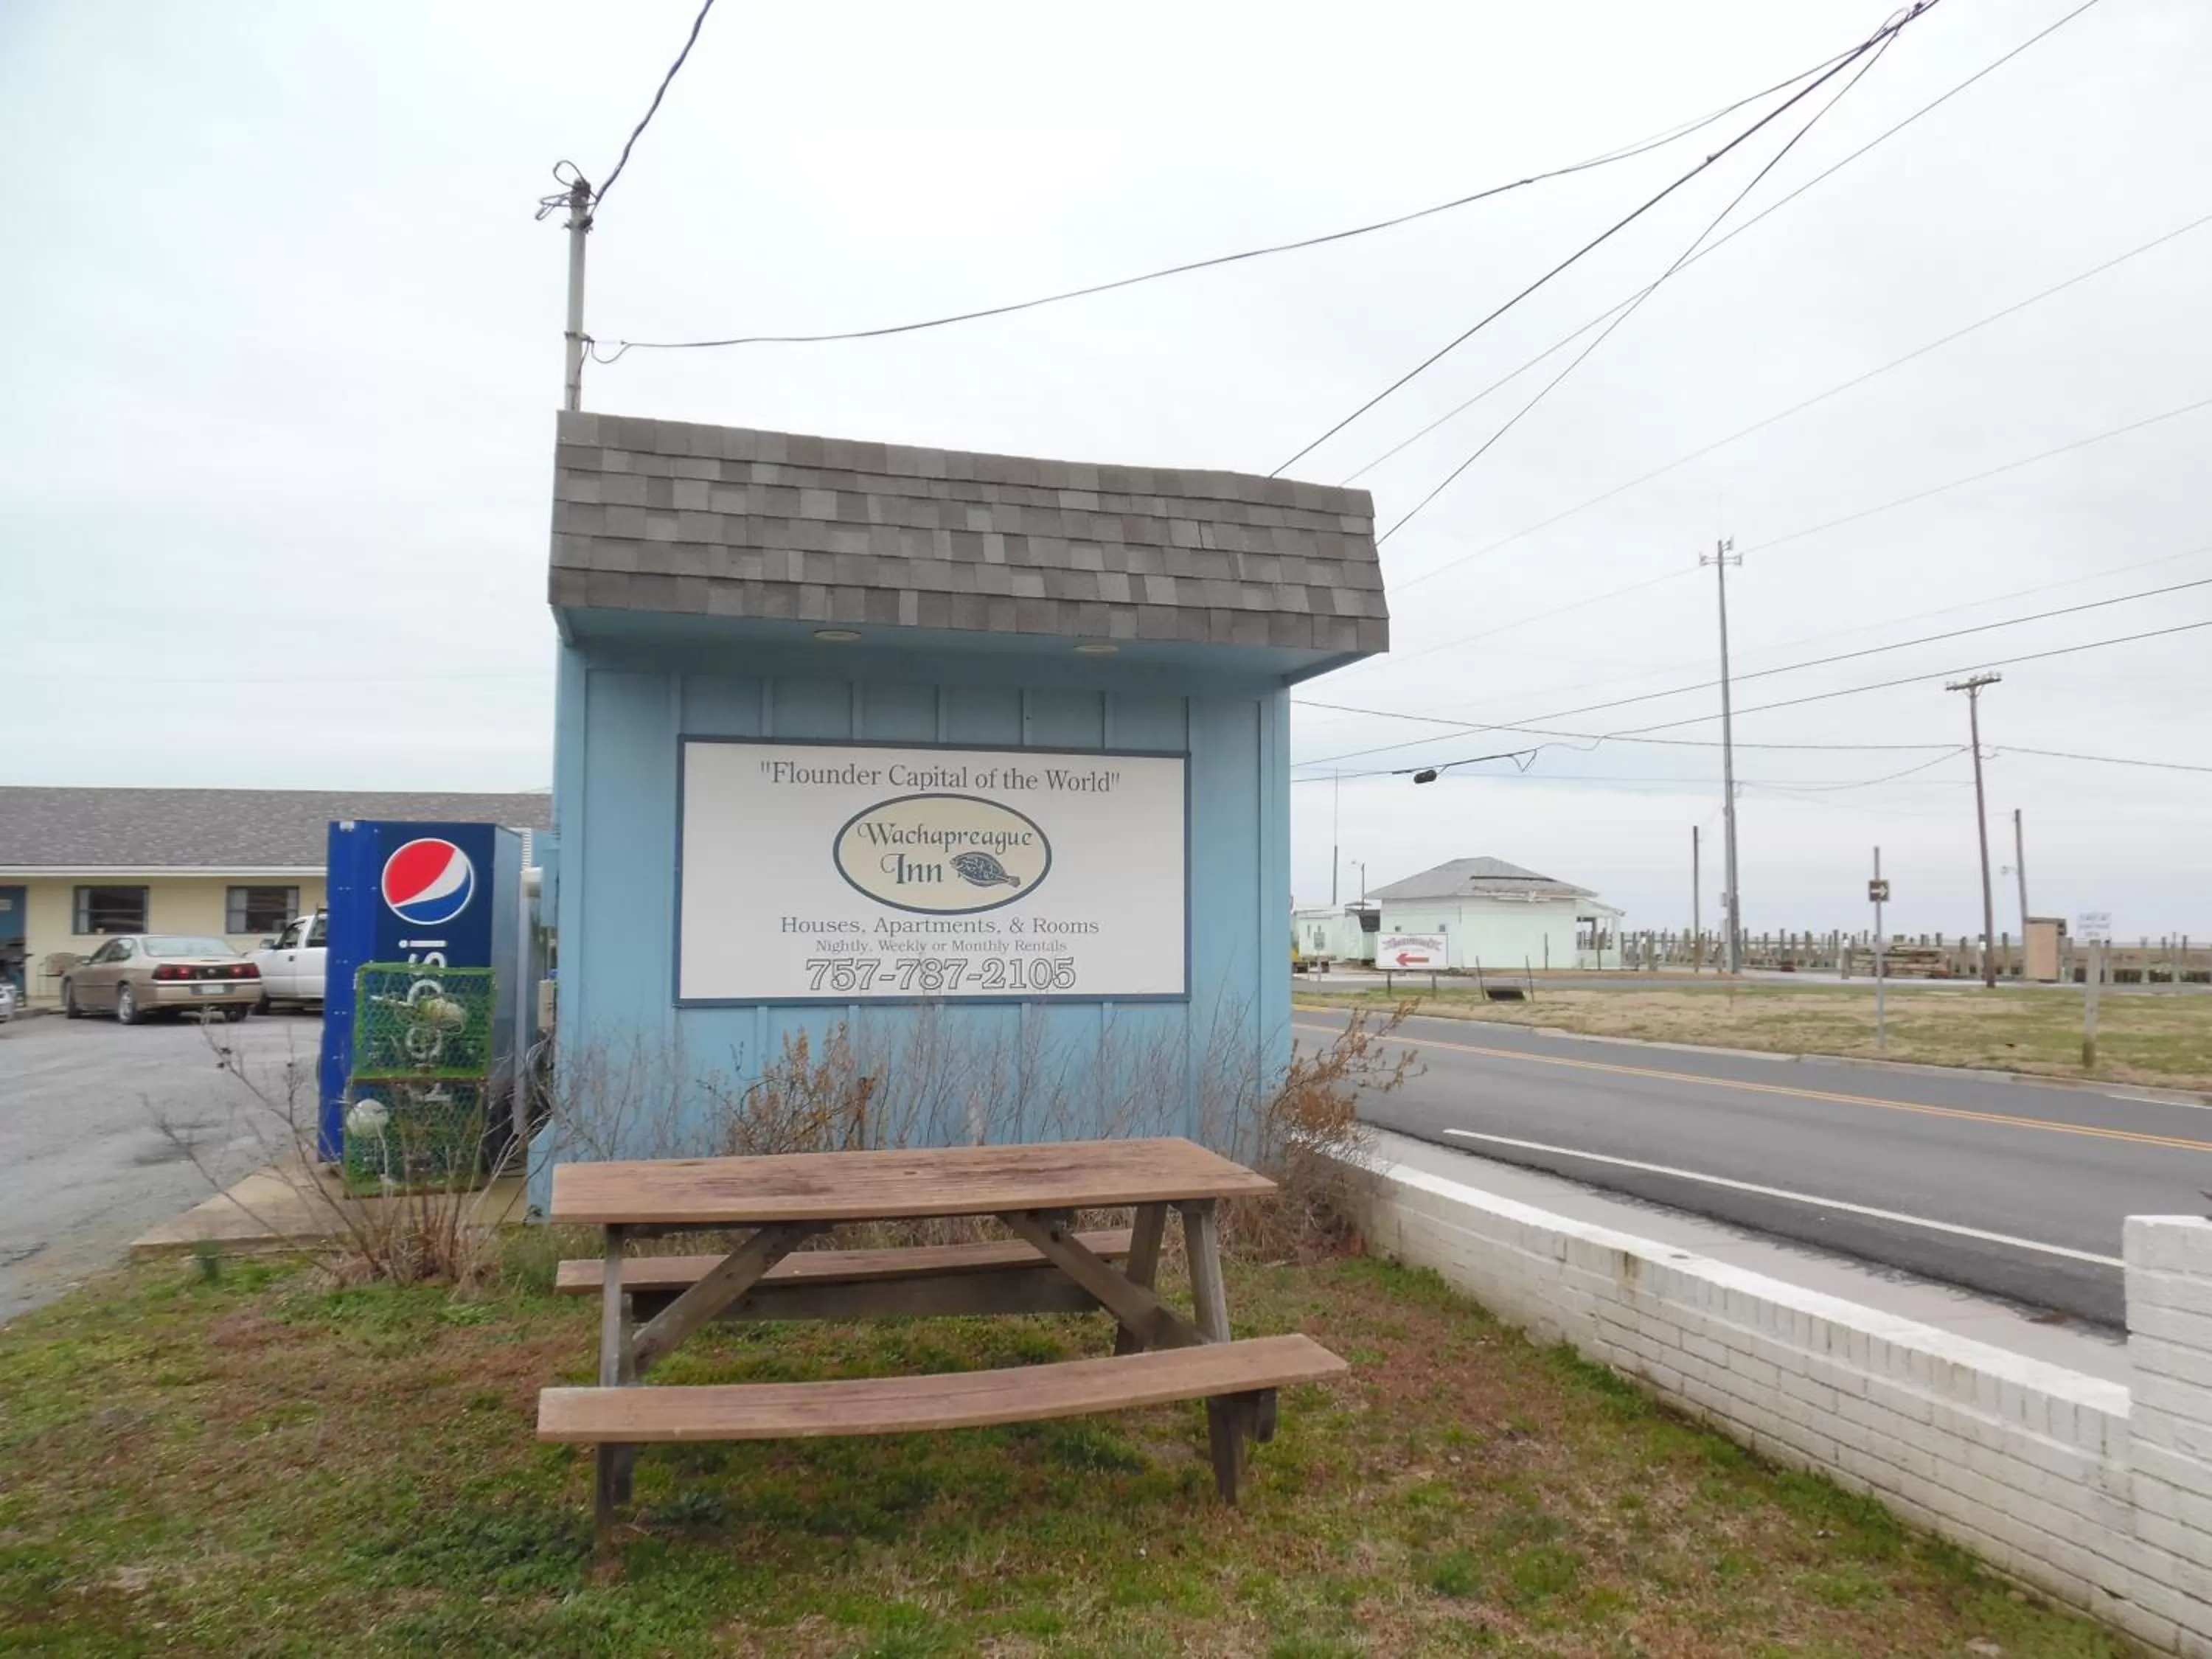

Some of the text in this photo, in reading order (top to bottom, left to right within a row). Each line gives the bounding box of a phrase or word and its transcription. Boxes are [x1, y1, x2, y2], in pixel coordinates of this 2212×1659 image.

[760, 760, 1121, 793] "Flounder Capital of the World"
[857, 822, 1033, 856] Wachapreague
[880, 852, 944, 885] Inn
[1009, 917, 1026, 933] &
[1032, 917, 1099, 933] Rooms
[877, 939, 927, 954] Weekly
[931, 943, 947, 952] or
[951, 939, 1010, 953] Monthly
[1015, 940, 1068, 952] Rentals
[805, 956, 1077, 991] 757-787-2105
